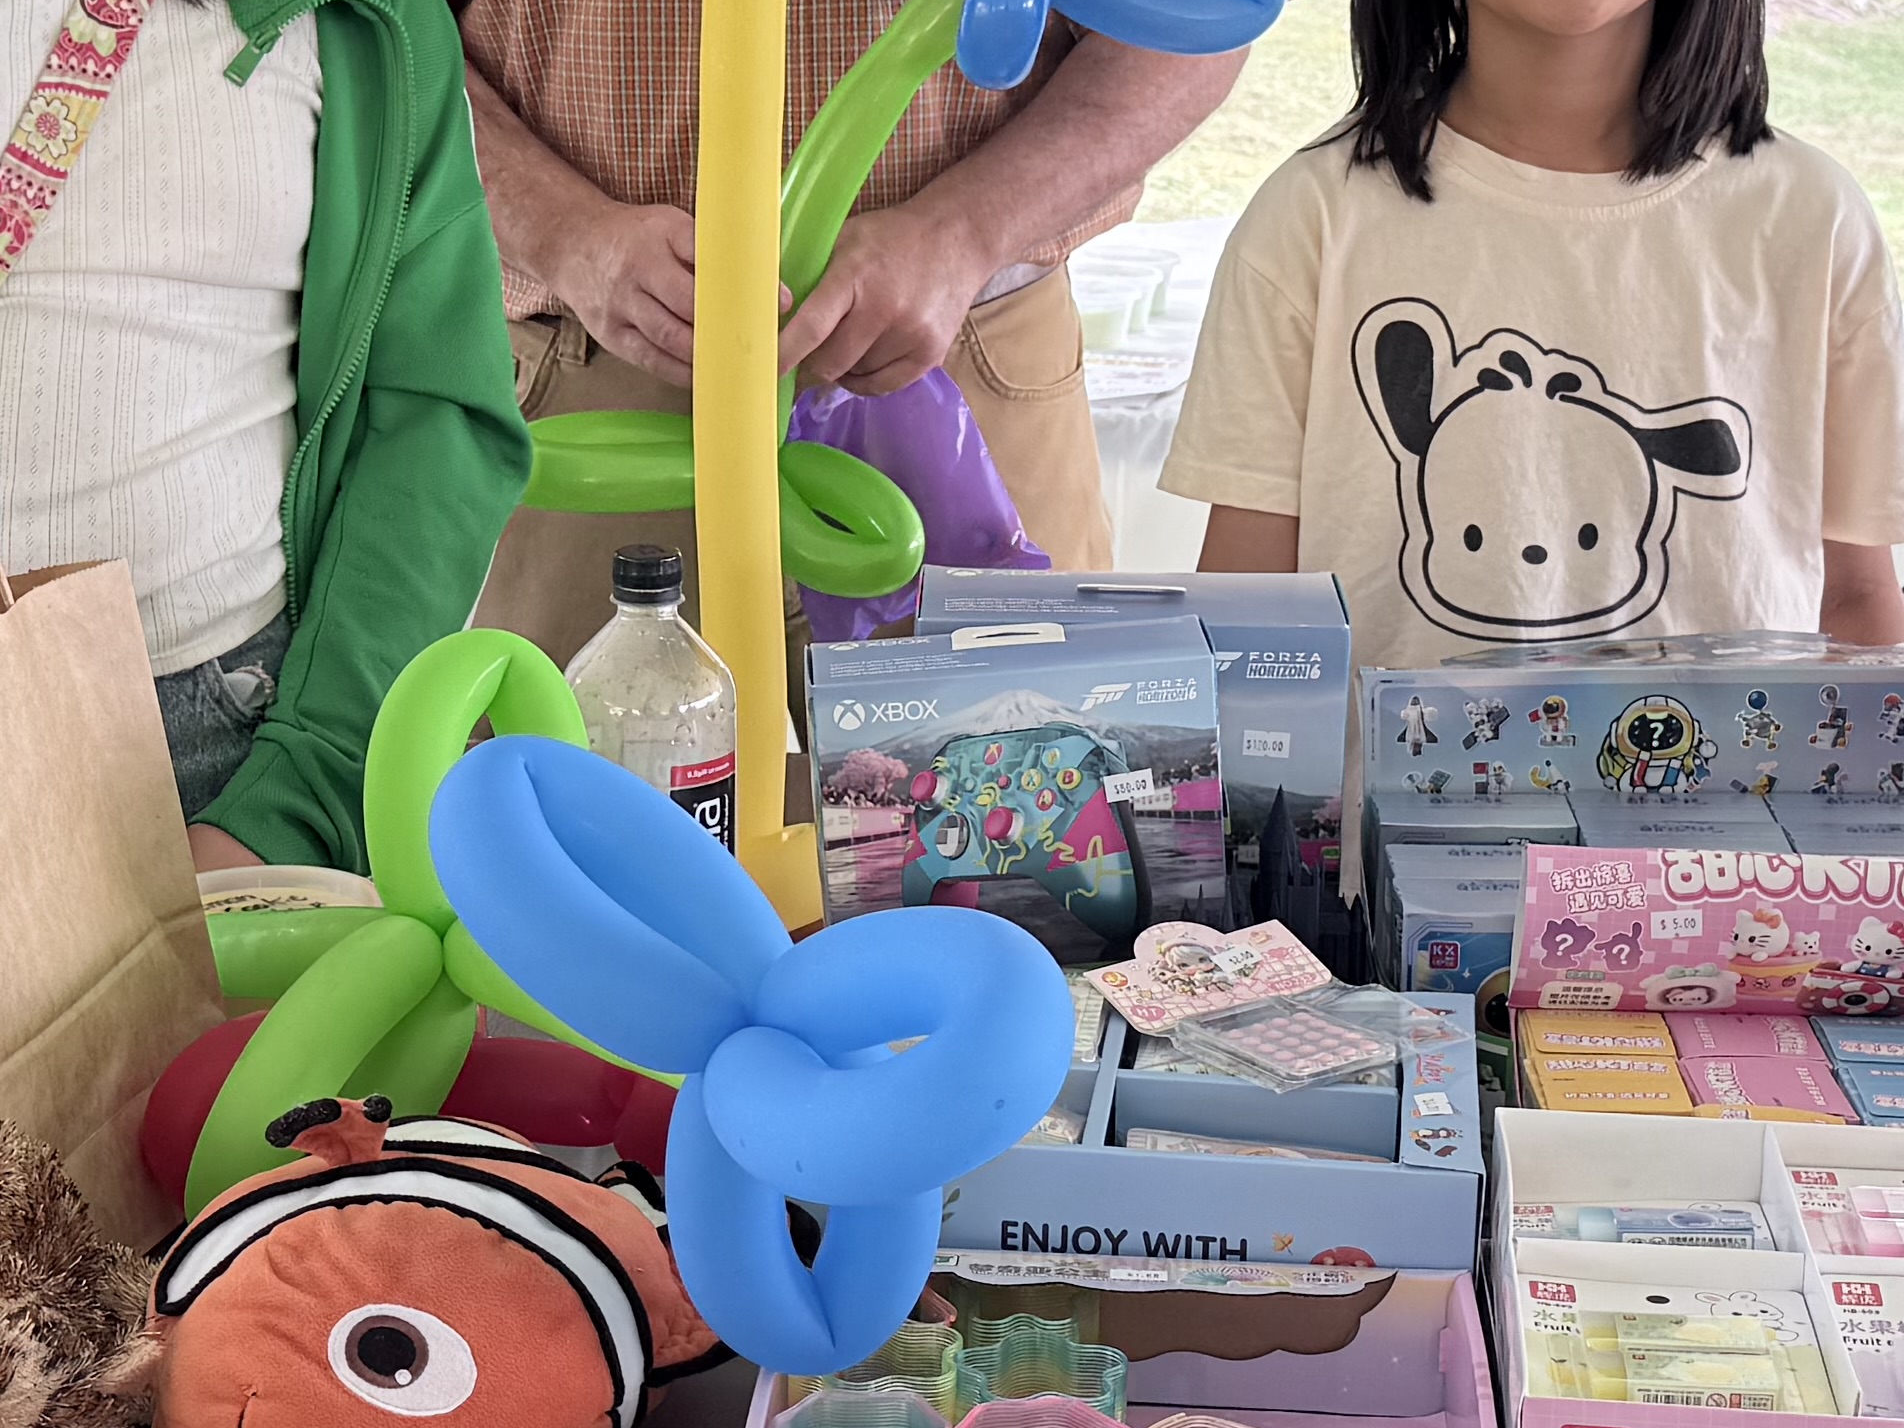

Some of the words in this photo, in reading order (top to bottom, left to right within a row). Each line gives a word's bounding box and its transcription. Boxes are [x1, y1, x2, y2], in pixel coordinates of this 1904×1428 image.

[1248, 651, 1322, 663] FORZA
[1136, 677, 1197, 689] FORZA
[1246, 663, 1309, 680] HORIZON
[870, 699, 940, 724] XBOX
[1550, 861, 1635, 894] 拆出惊喜
[1566, 882, 1647, 915] 遇见可爱
[1000, 1220, 1128, 1256] ENJOY
[1142, 1231, 1249, 1262] WITH
